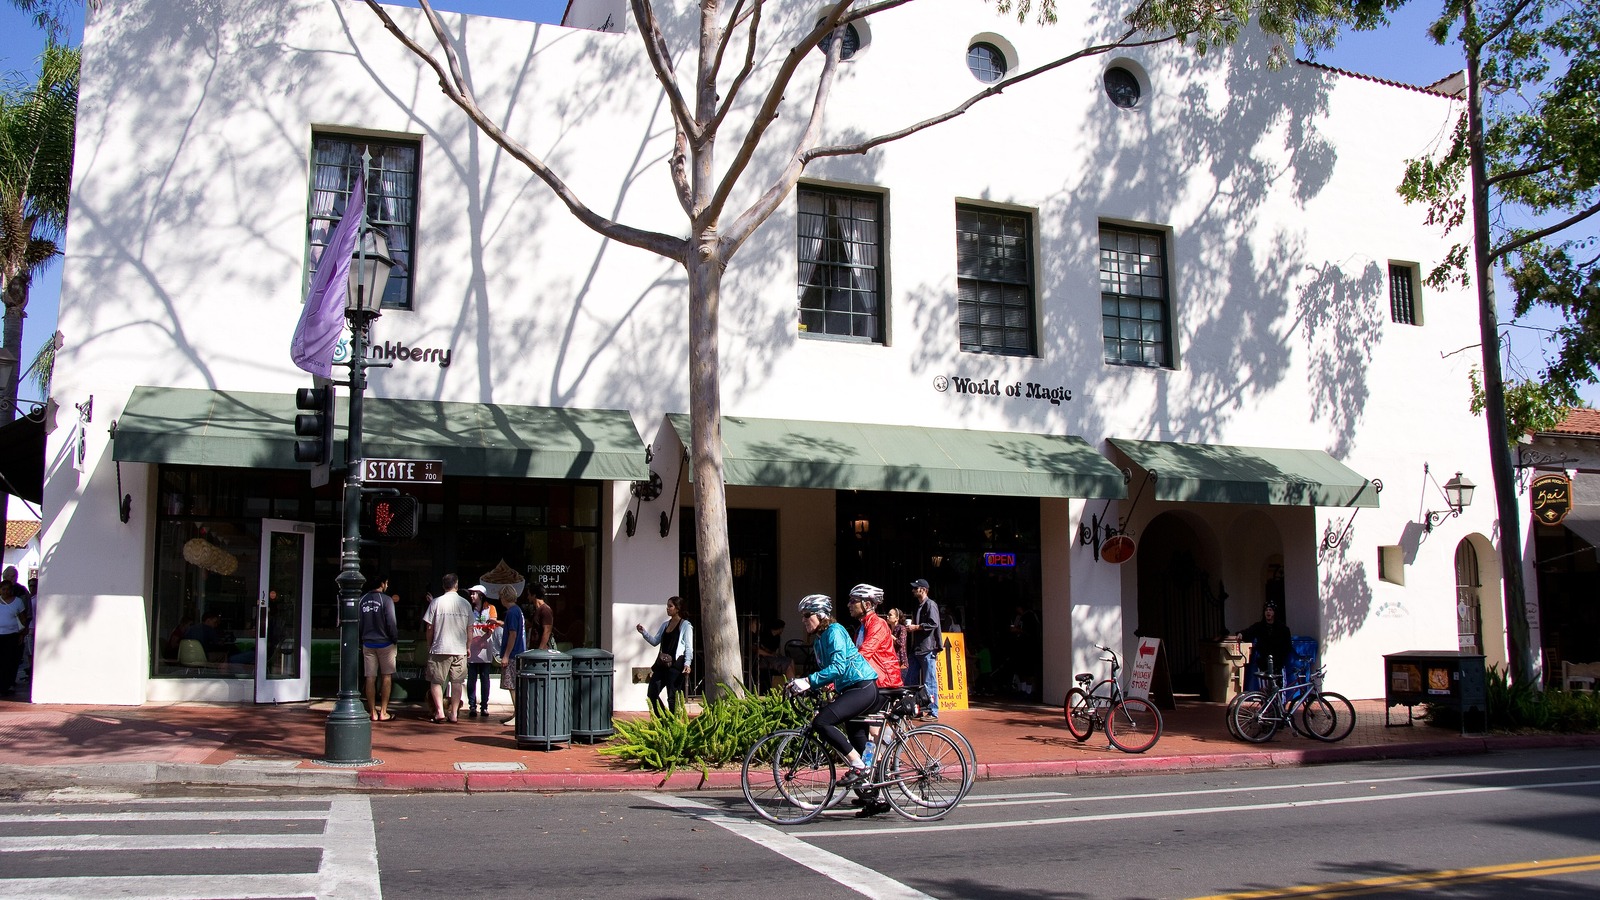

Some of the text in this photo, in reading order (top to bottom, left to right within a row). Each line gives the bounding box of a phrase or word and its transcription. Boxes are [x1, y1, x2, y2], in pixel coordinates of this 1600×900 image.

[372, 340, 451, 368] nkberry
[951, 376, 1072, 406] World of Magic
[369, 461, 415, 480] STATE
[987, 554, 1015, 565] OPEN
[527, 564, 571, 573] PINKBERRY
[538, 574, 560, 583] PB+J
[954, 640, 963, 690] COSTUMES
[1131, 680, 1148, 691] STORE
[956, 692, 963, 700] of
[941, 701, 957, 710] Magic
